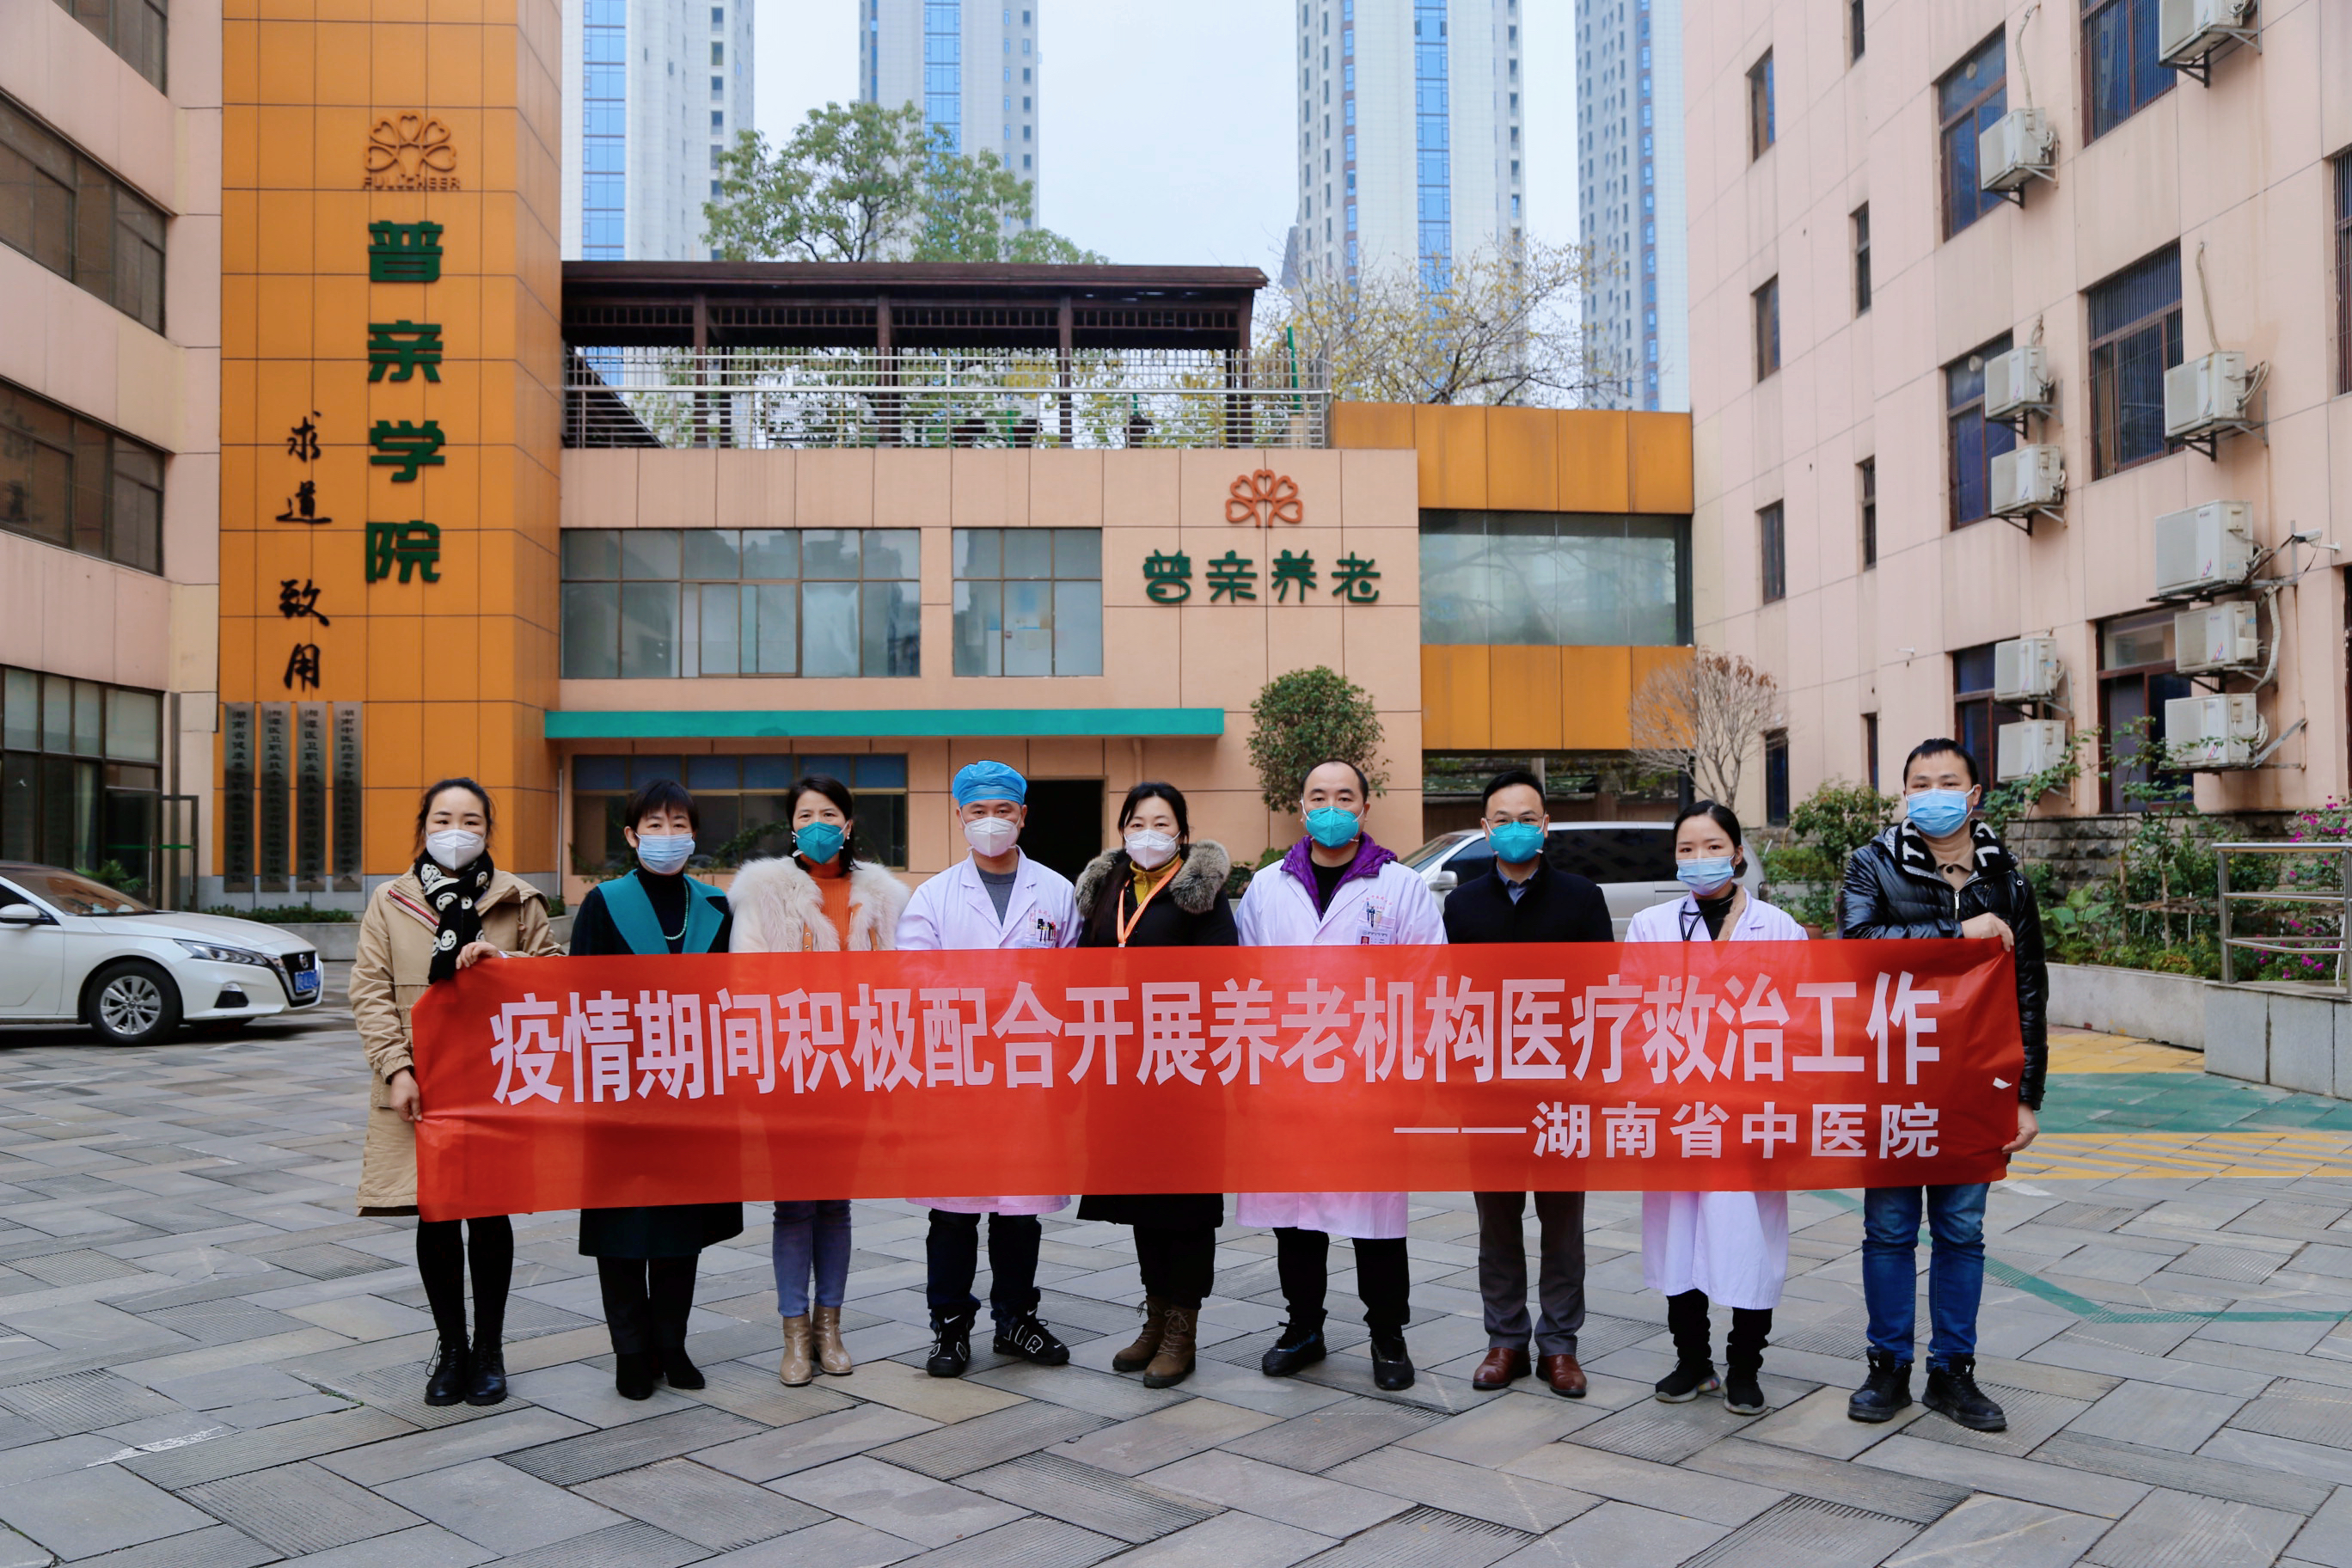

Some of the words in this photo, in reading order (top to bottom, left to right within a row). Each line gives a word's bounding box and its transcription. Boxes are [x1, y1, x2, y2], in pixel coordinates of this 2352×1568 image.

[363, 176, 460, 190] FULLCHEER
[366, 220, 445, 584] 普亲学院
[276, 411, 332, 692] 求道致用
[1142, 549, 1381, 603] 普亲养老
[490, 971, 1940, 1106] 疫情期间积极配合开展养老机构医疗救治工作
